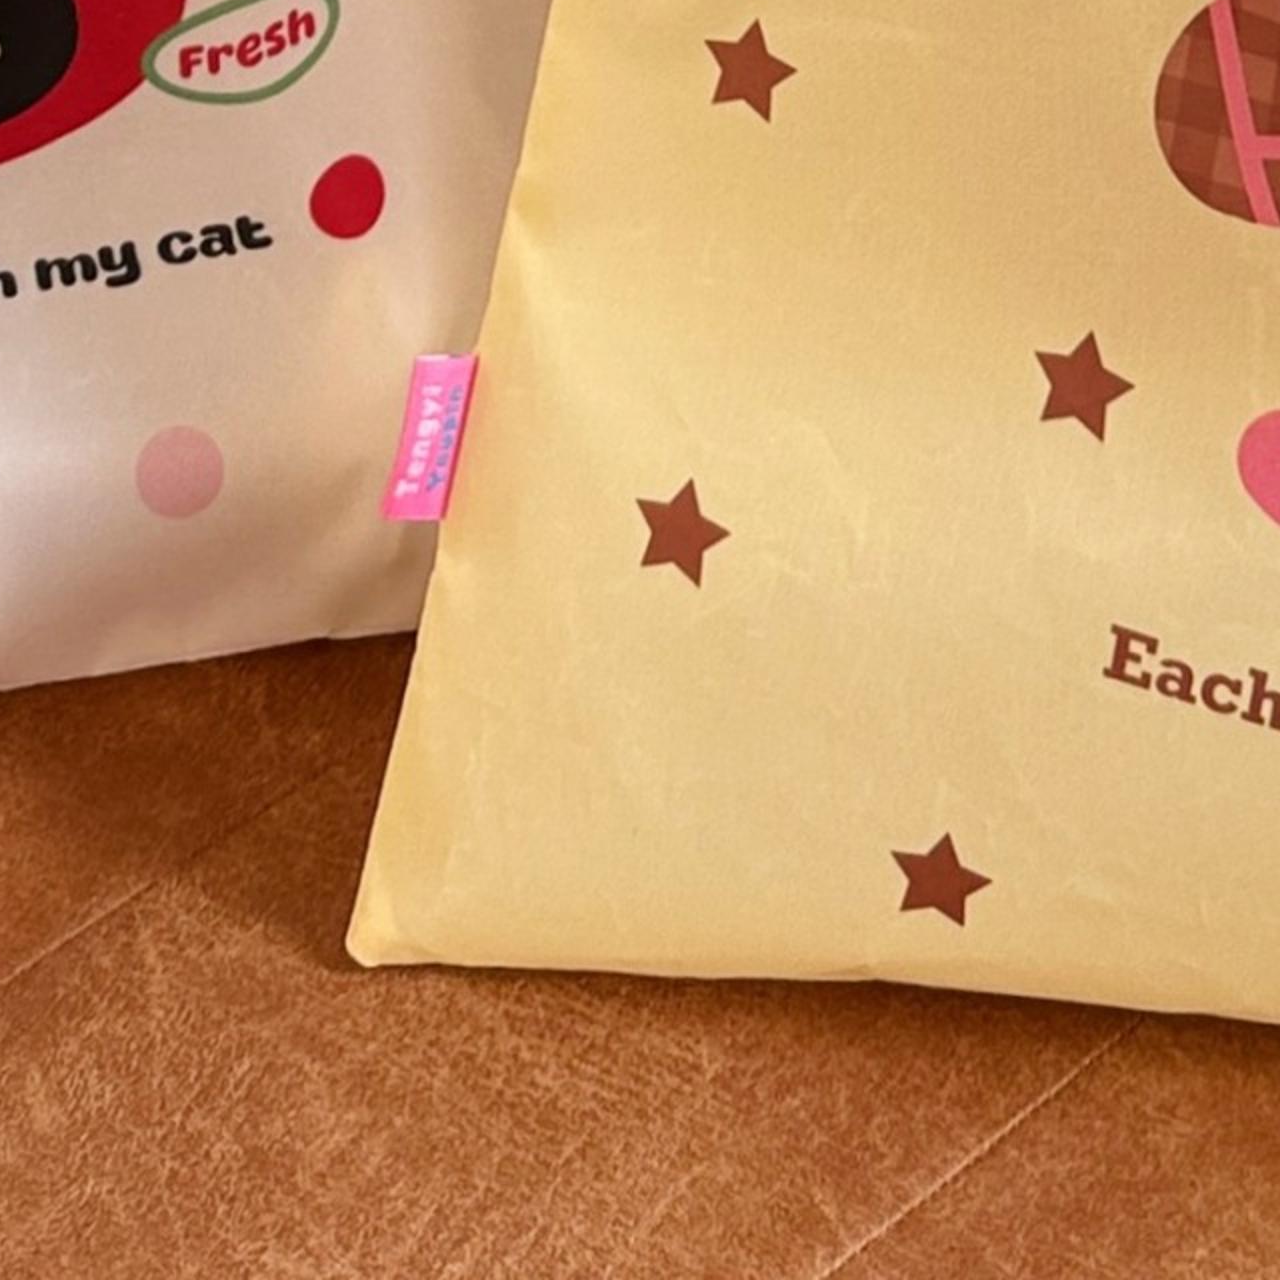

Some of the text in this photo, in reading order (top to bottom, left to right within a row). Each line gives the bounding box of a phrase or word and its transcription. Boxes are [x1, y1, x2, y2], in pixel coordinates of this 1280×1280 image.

[177, 7, 317, 80] Fresh
[34, 240, 143, 292] my
[155, 214, 275, 266] cat
